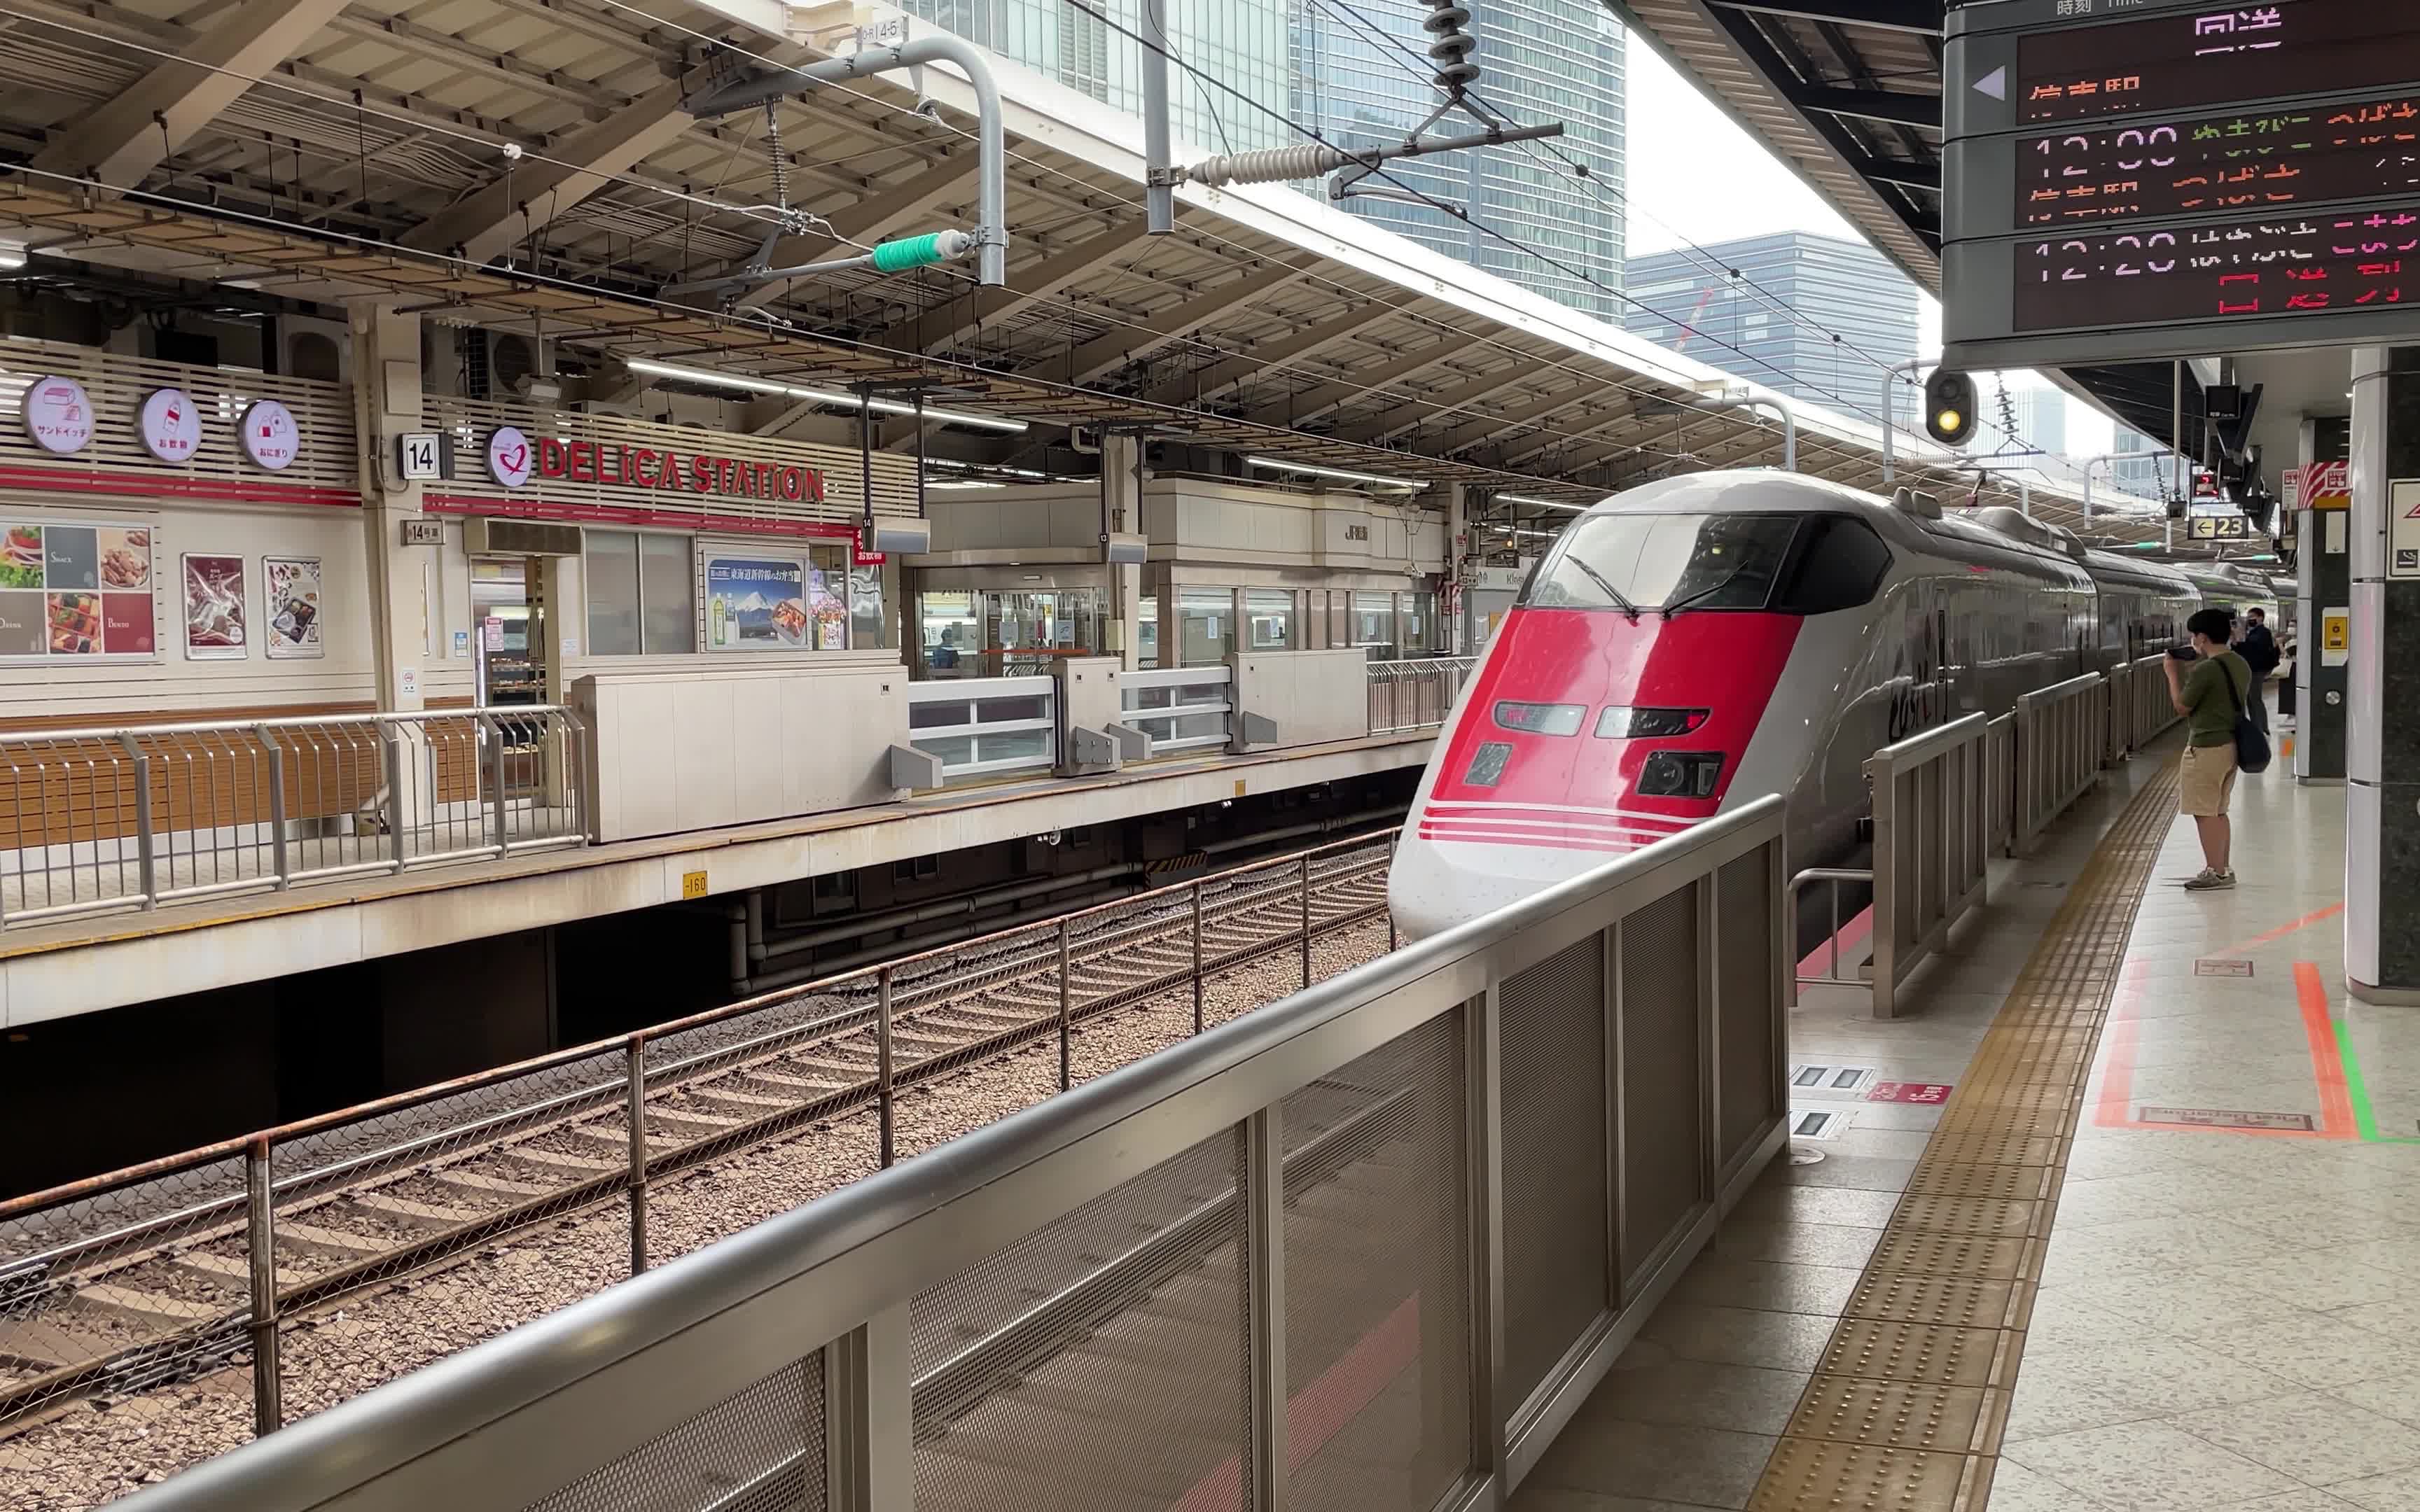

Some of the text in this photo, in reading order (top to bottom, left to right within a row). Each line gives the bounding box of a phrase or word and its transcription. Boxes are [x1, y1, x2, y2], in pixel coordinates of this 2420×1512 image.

[2057, 0, 2092, 15] 時刻
[409, 442, 433, 470] 14
[2217, 518, 2243, 536] 23
